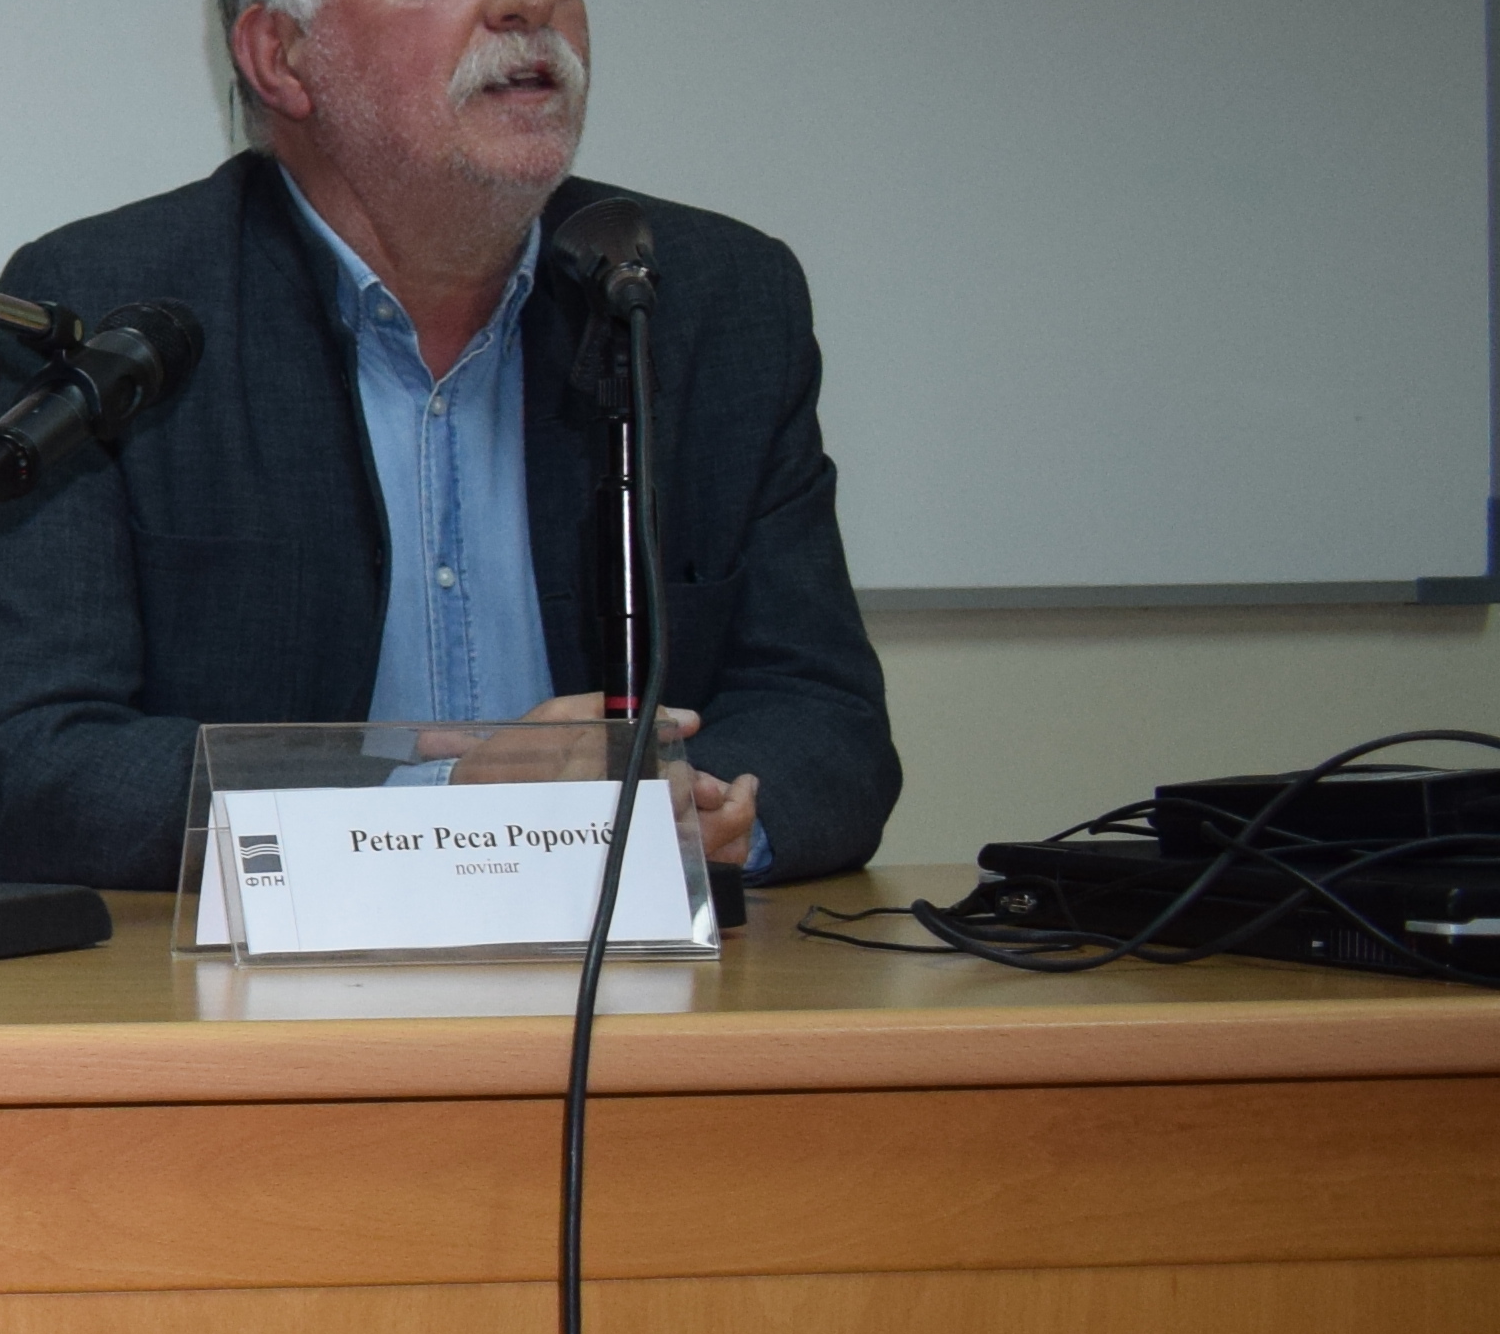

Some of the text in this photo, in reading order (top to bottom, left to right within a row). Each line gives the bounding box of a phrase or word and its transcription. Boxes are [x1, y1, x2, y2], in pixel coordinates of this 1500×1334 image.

[350, 822, 614, 853] Petar Peca Popović
[455, 859, 520, 876] novinar
[246, 875, 286, 887] ФПН
